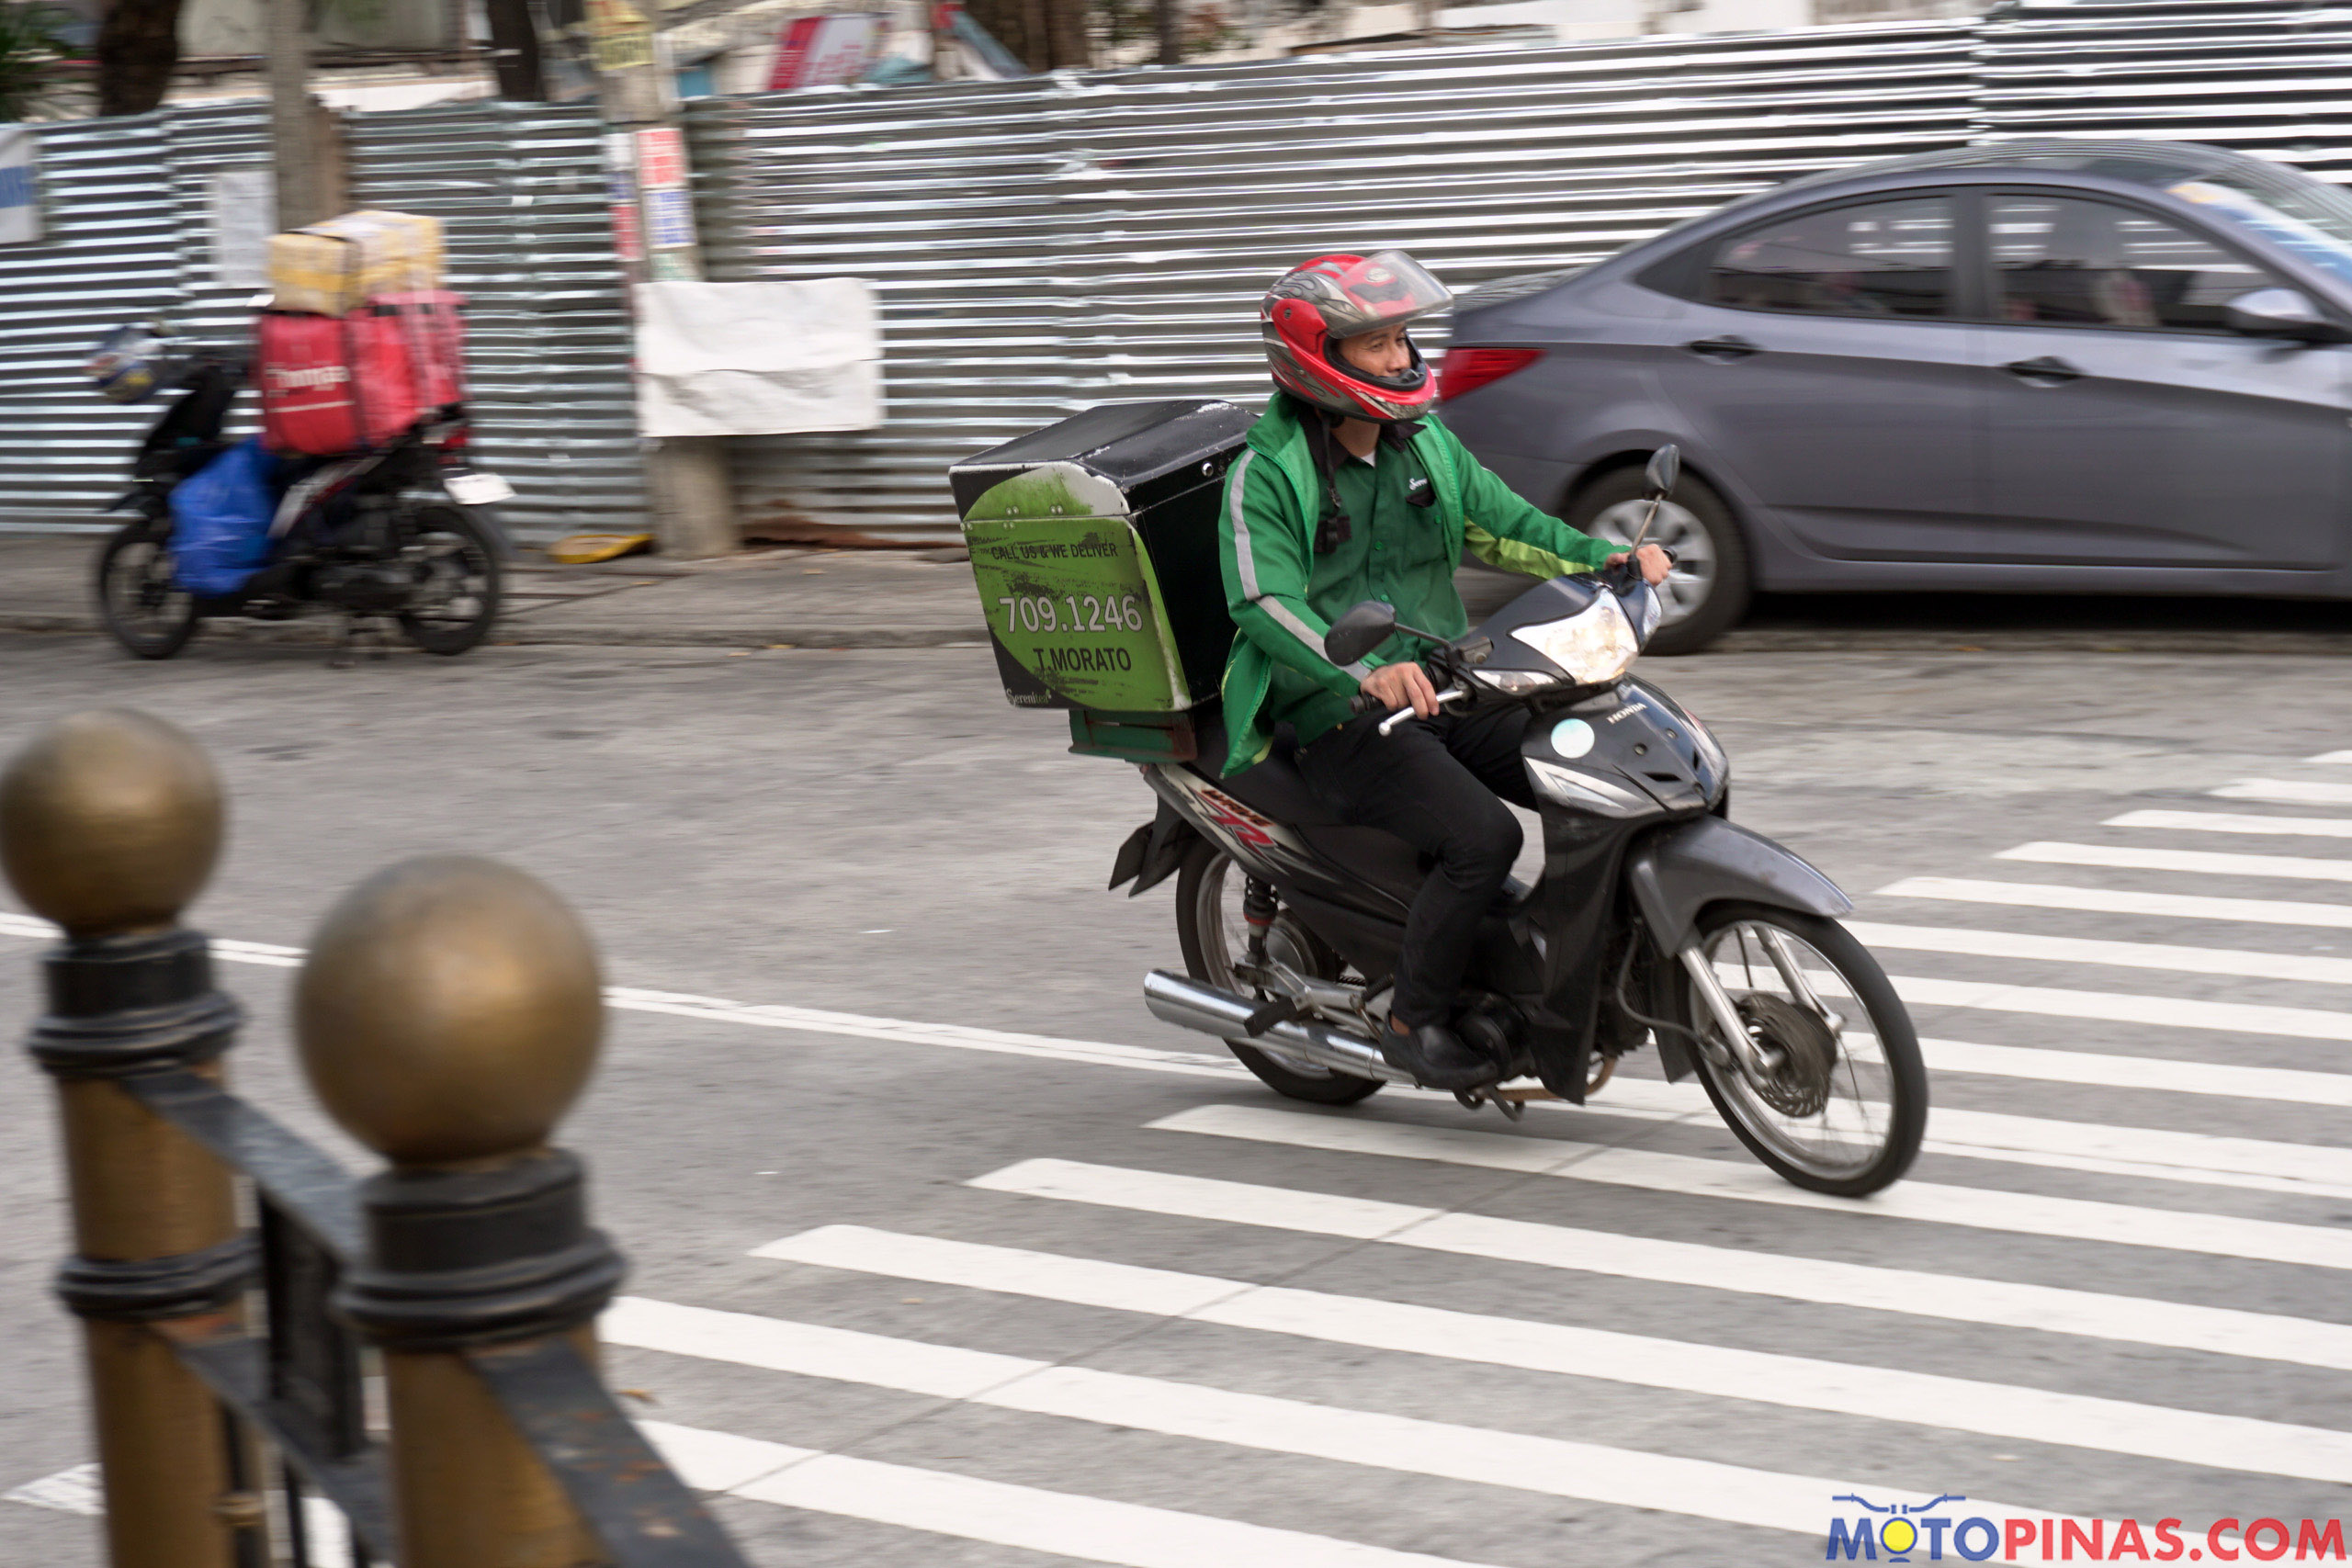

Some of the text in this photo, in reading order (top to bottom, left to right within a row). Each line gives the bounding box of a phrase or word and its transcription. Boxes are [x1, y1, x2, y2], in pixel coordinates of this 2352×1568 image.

[991, 542, 1118, 560] CALL US & WE DELIVER
[999, 595, 1143, 633] 709.1246
[1033, 648, 1132, 671] T.MORATO
[1606, 703, 1647, 725] HONDA
